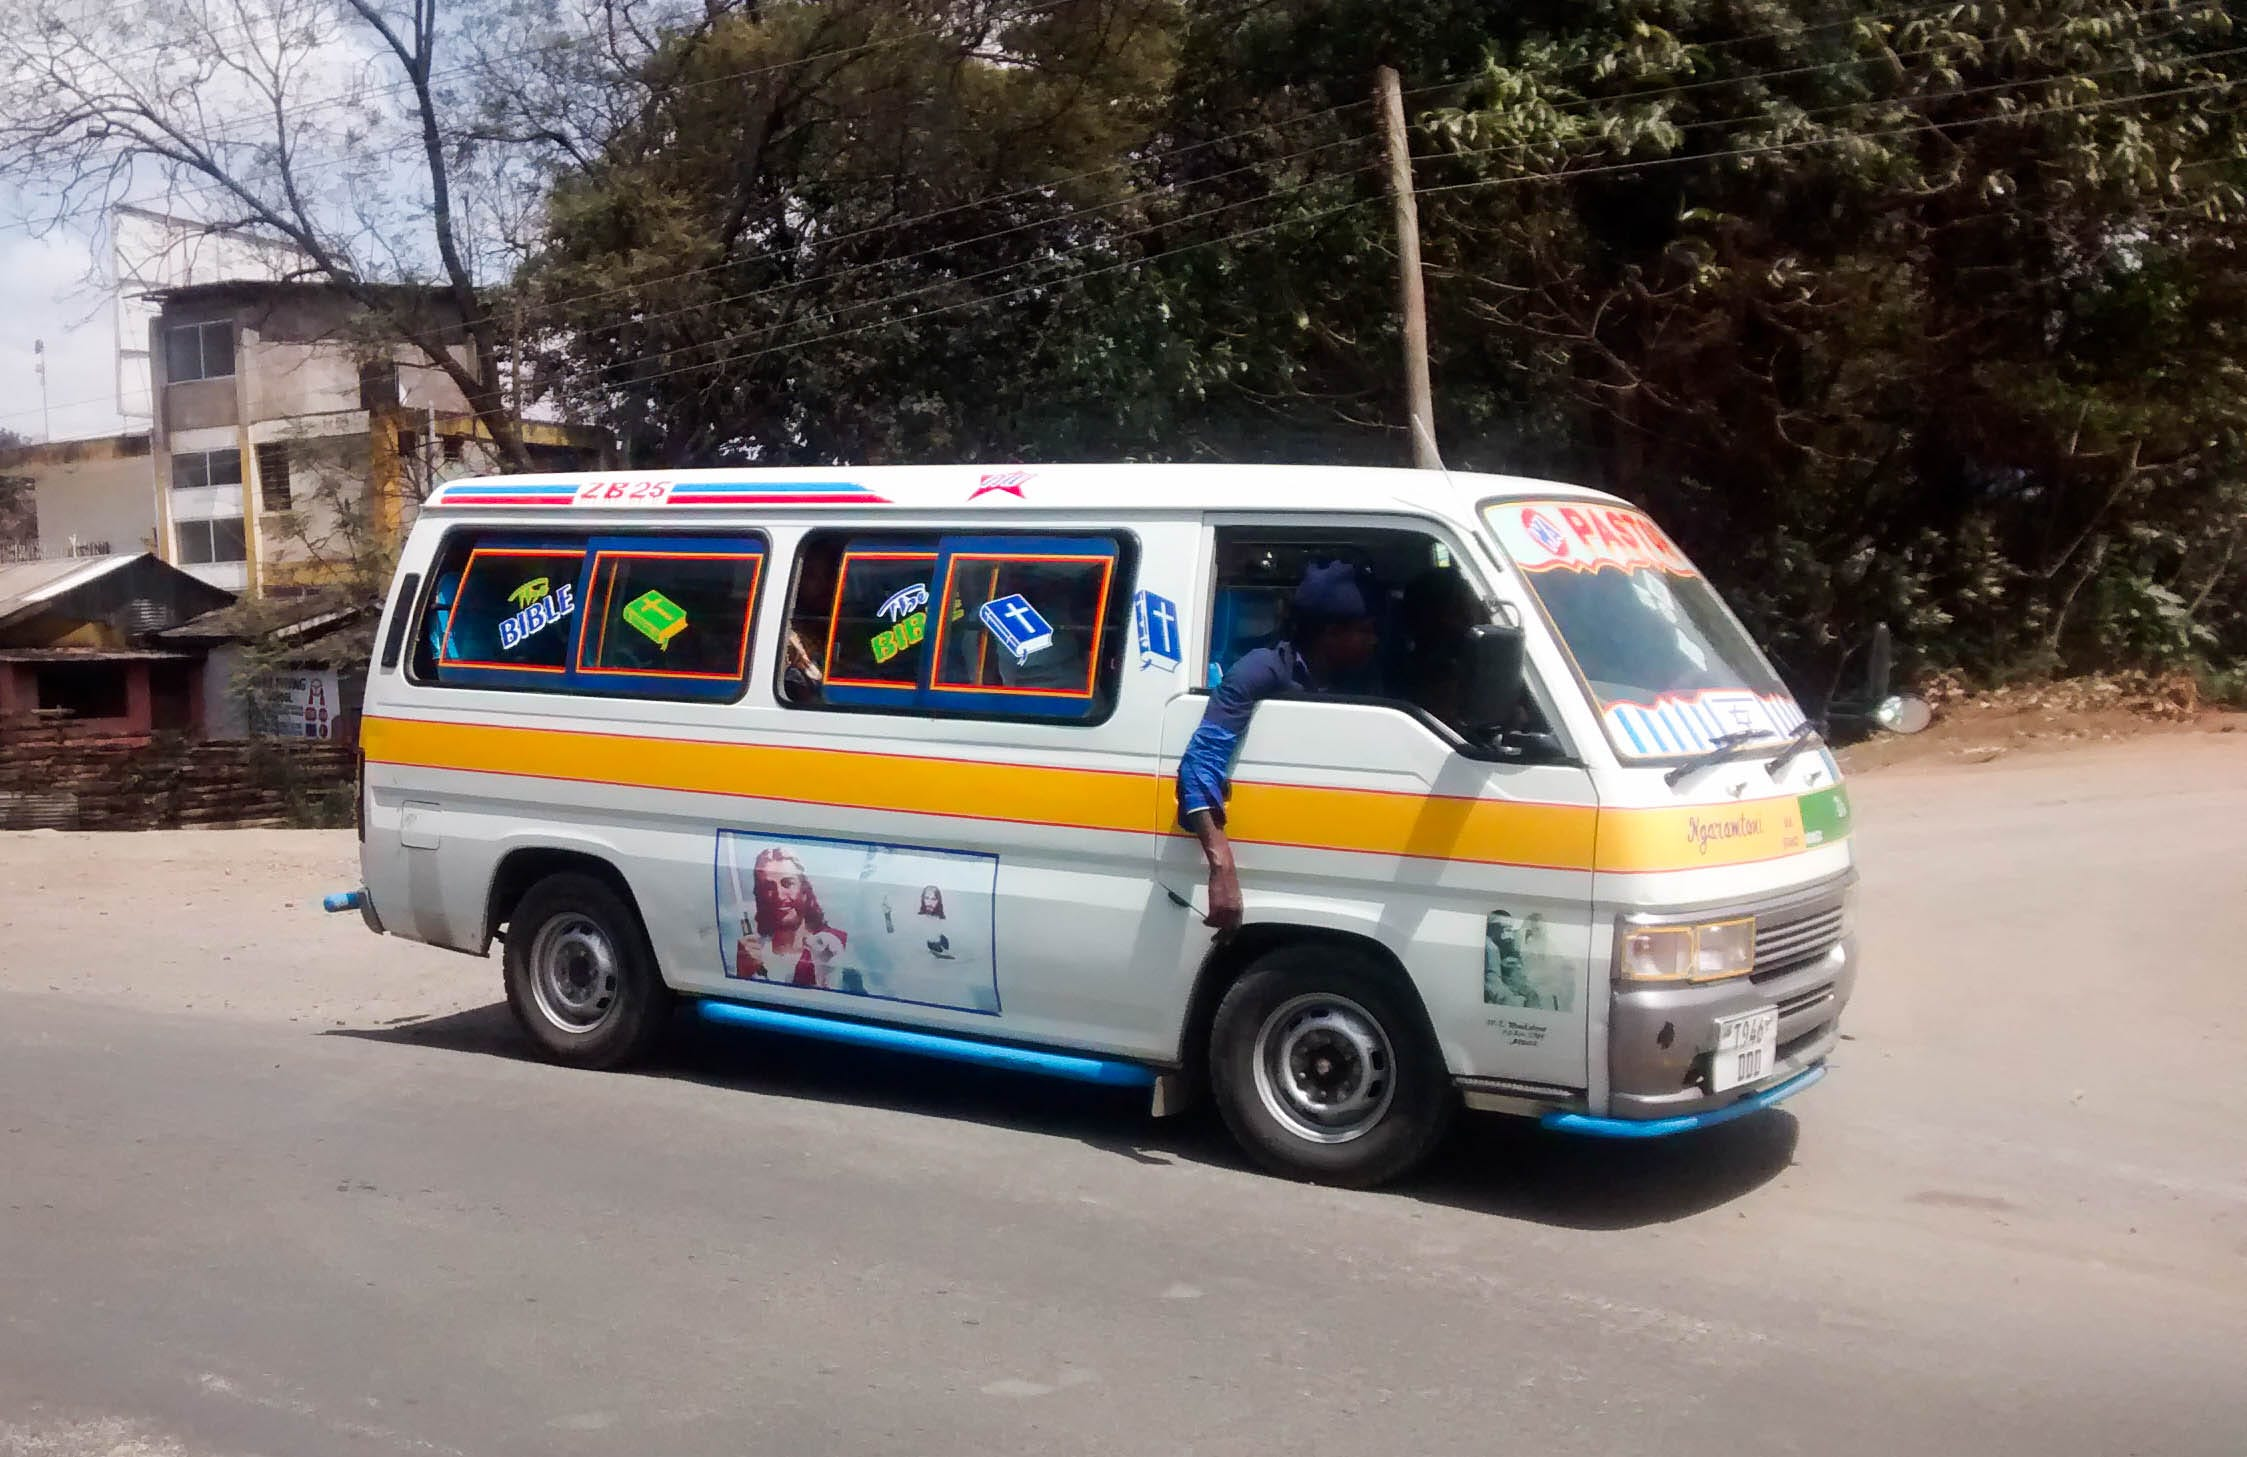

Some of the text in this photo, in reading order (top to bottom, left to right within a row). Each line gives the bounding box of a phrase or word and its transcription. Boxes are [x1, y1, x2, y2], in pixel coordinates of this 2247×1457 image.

[499, 583, 575, 650] BIBLE
[877, 583, 929, 622] The
[1737, 1049, 1762, 1082] DDD
